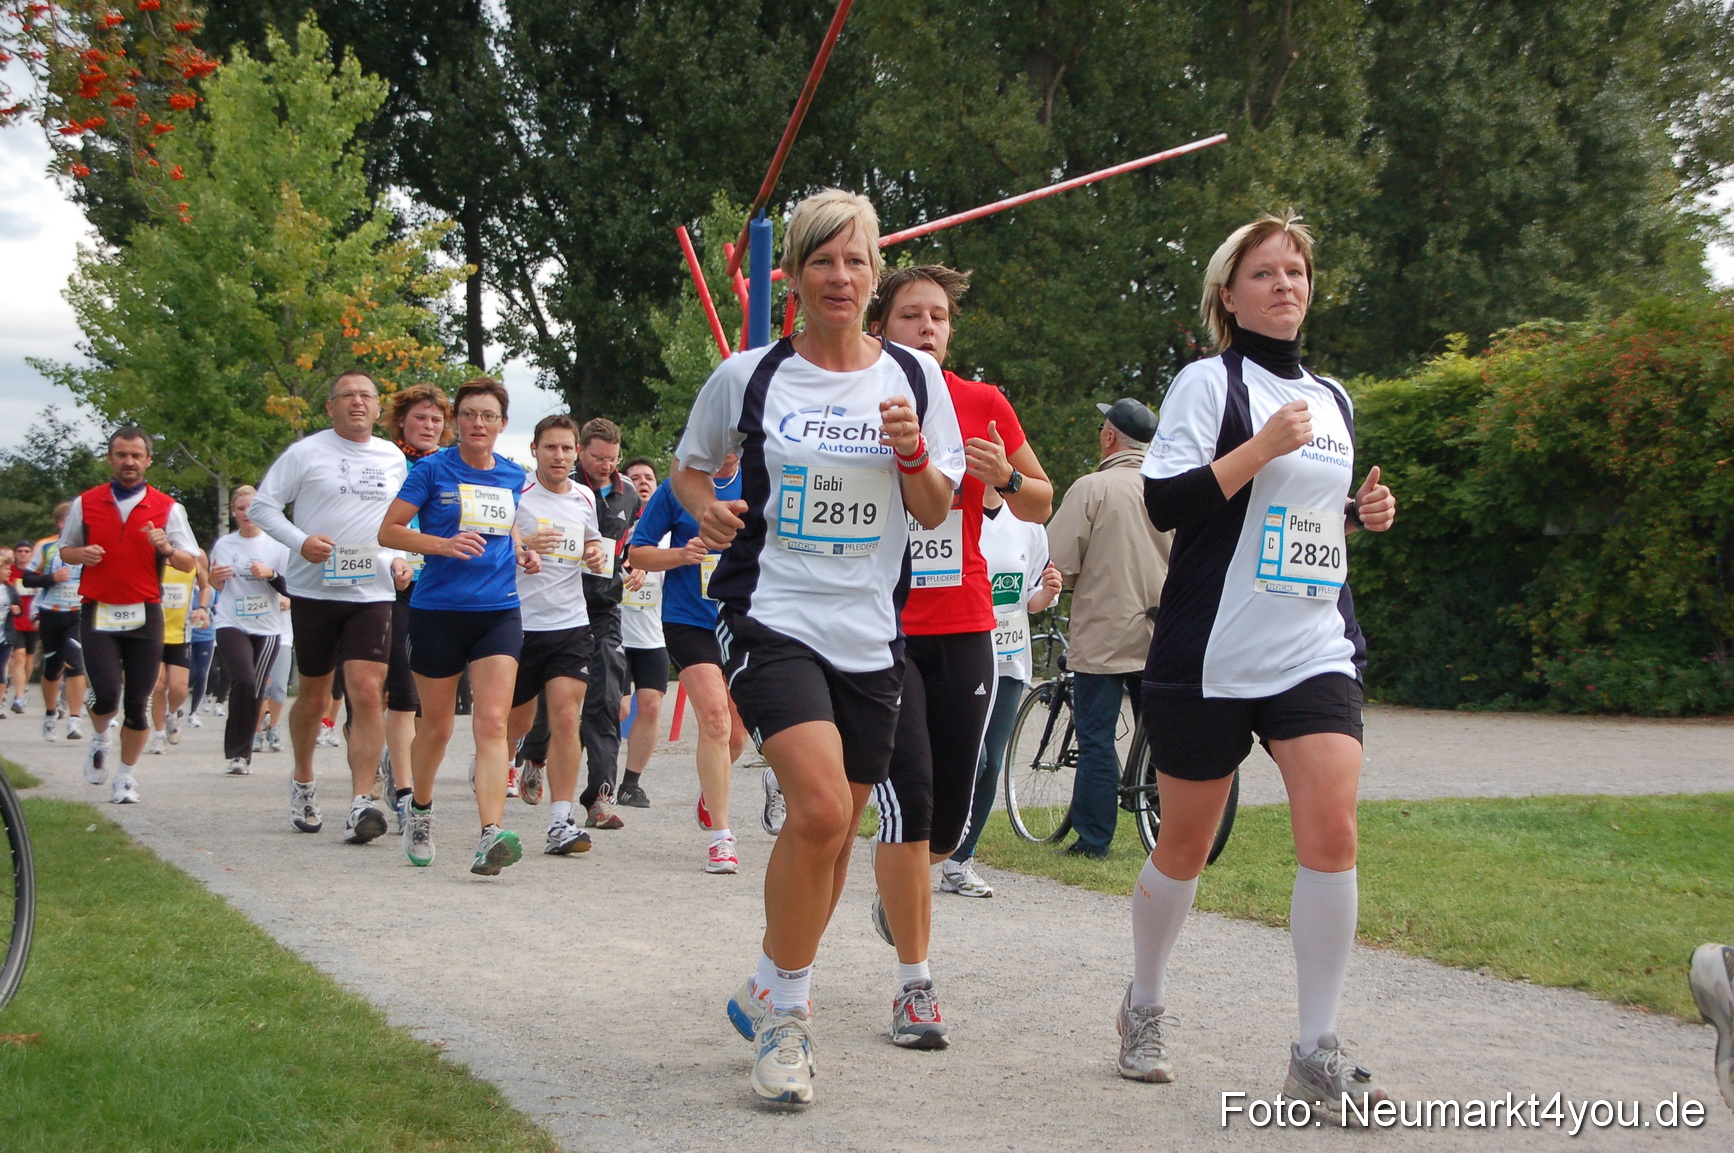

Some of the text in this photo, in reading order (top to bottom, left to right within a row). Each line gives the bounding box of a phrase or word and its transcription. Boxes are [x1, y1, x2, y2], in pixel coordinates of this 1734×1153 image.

[814, 474, 843, 492] Gabi
[474, 489, 500, 501] Christa
[787, 497, 794, 509] C
[481, 504, 507, 520] 756
[812, 501, 877, 525] 2819
[1290, 514, 1321, 534] Petra
[911, 539, 953, 560] 265
[1268, 537, 1275, 550] C
[340, 547, 359, 556] Peter
[1290, 541, 1340, 569] 2820
[341, 558, 373, 571] 2648
[991, 574, 1022, 590] AOK
[168, 592, 183, 600] 760
[247, 600, 269, 611] 2244
[114, 610, 136, 621] 981
[995, 629, 1023, 645] 2704
